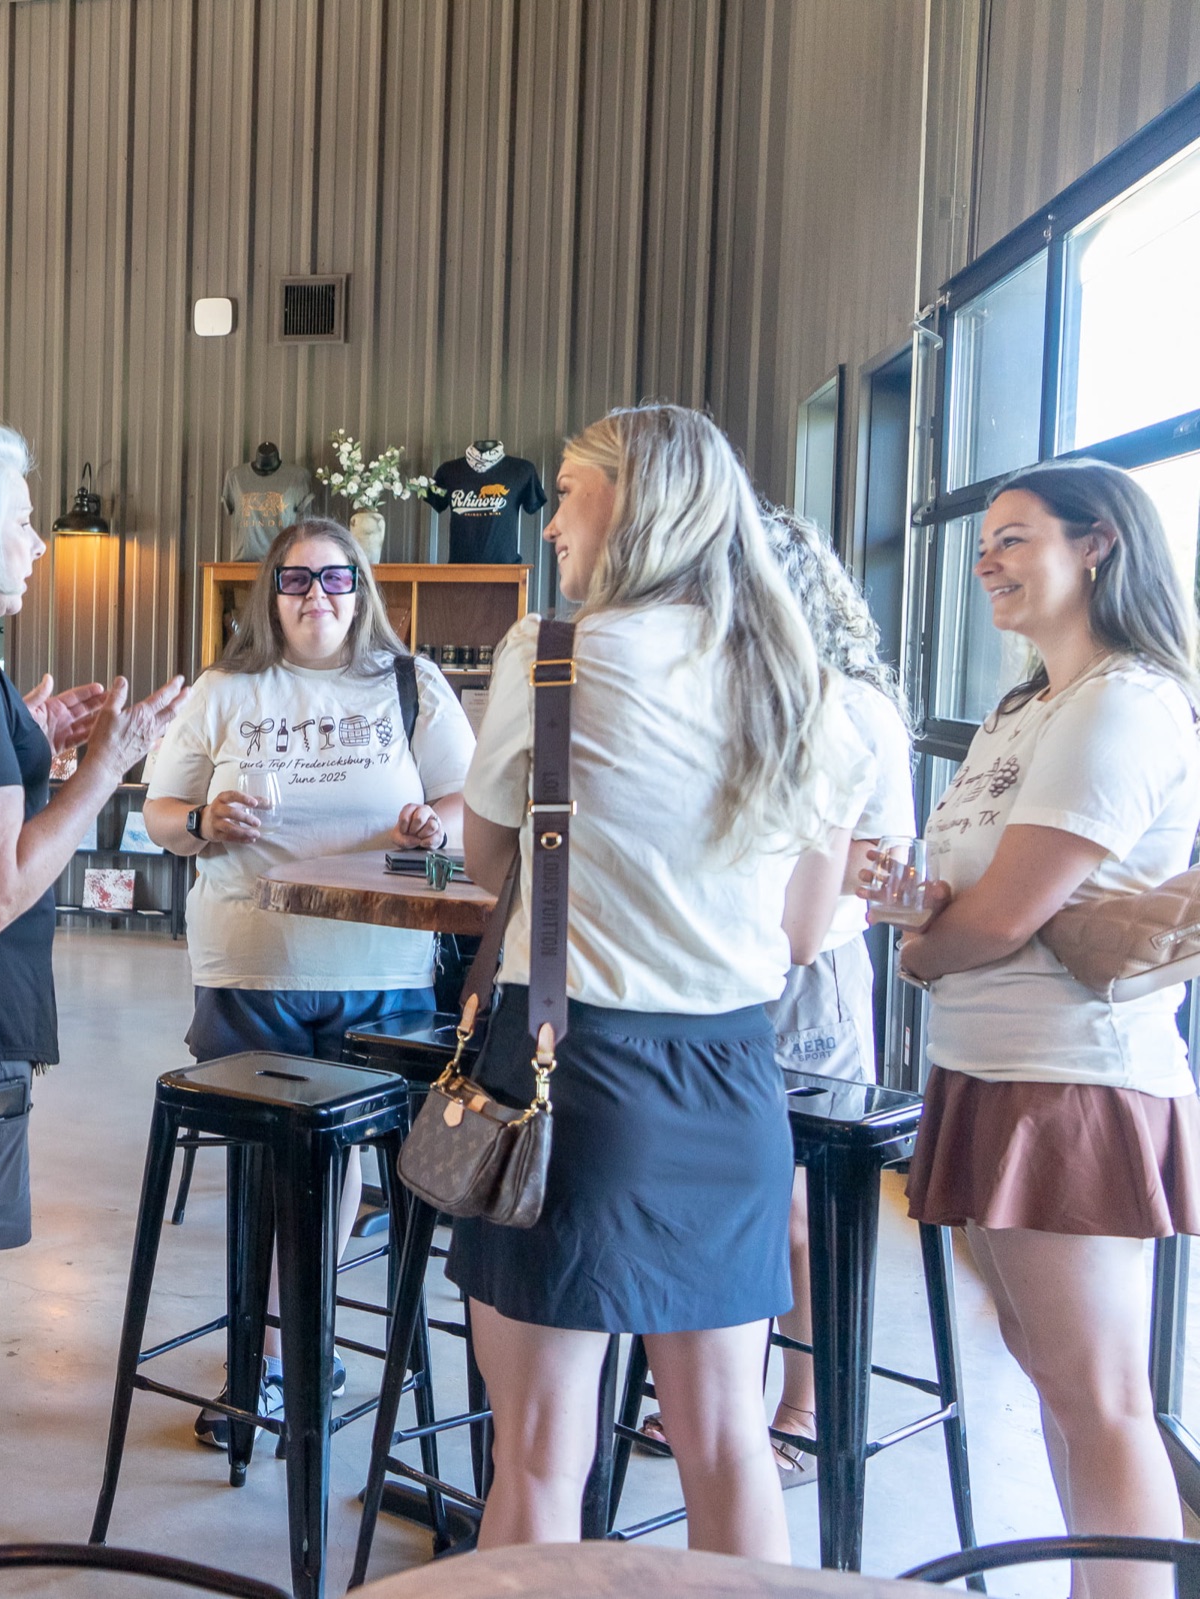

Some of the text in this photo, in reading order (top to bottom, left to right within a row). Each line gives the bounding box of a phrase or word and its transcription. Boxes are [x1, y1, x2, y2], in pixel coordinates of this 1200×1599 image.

[451, 489, 507, 512] Rhinory
[377, 753, 391, 764] TX
[288, 771, 347, 785] June 2025
[979, 811, 1000, 826] TX
[541, 854, 560, 956] LOUIS VUITTON
[792, 1037, 836, 1055] AERO
[798, 1051, 832, 1062] SPORT
